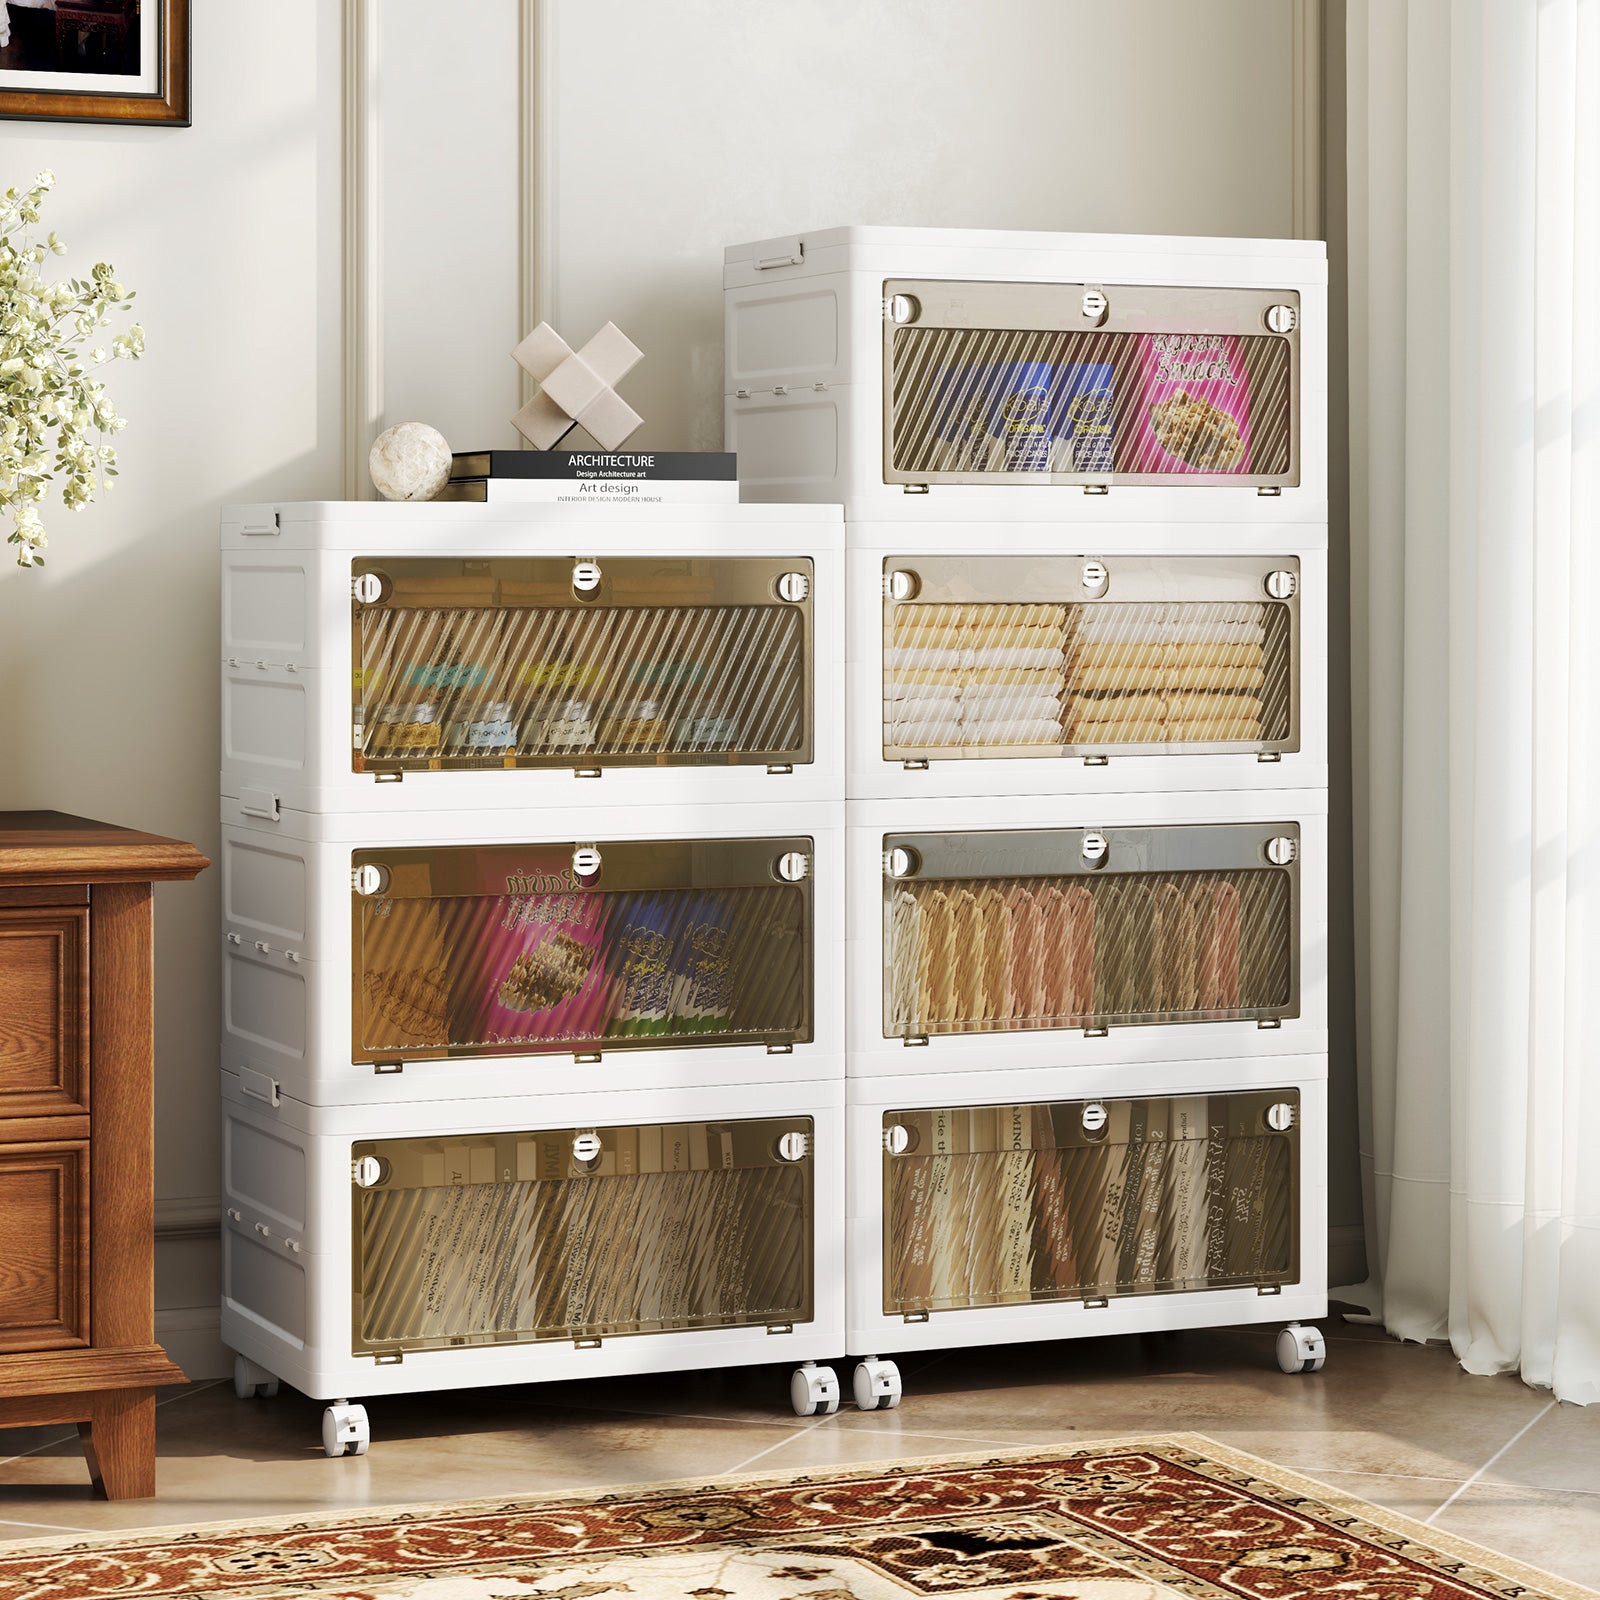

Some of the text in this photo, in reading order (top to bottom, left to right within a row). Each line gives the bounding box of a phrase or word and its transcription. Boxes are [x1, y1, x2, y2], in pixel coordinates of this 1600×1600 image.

[568, 454, 655, 467] ARCHITECTURE
[576, 470, 598, 479] Design
[599, 470, 636, 478] Architecture
[579, 483, 639, 496] Art design
[588, 495, 612, 503] DESIGN
